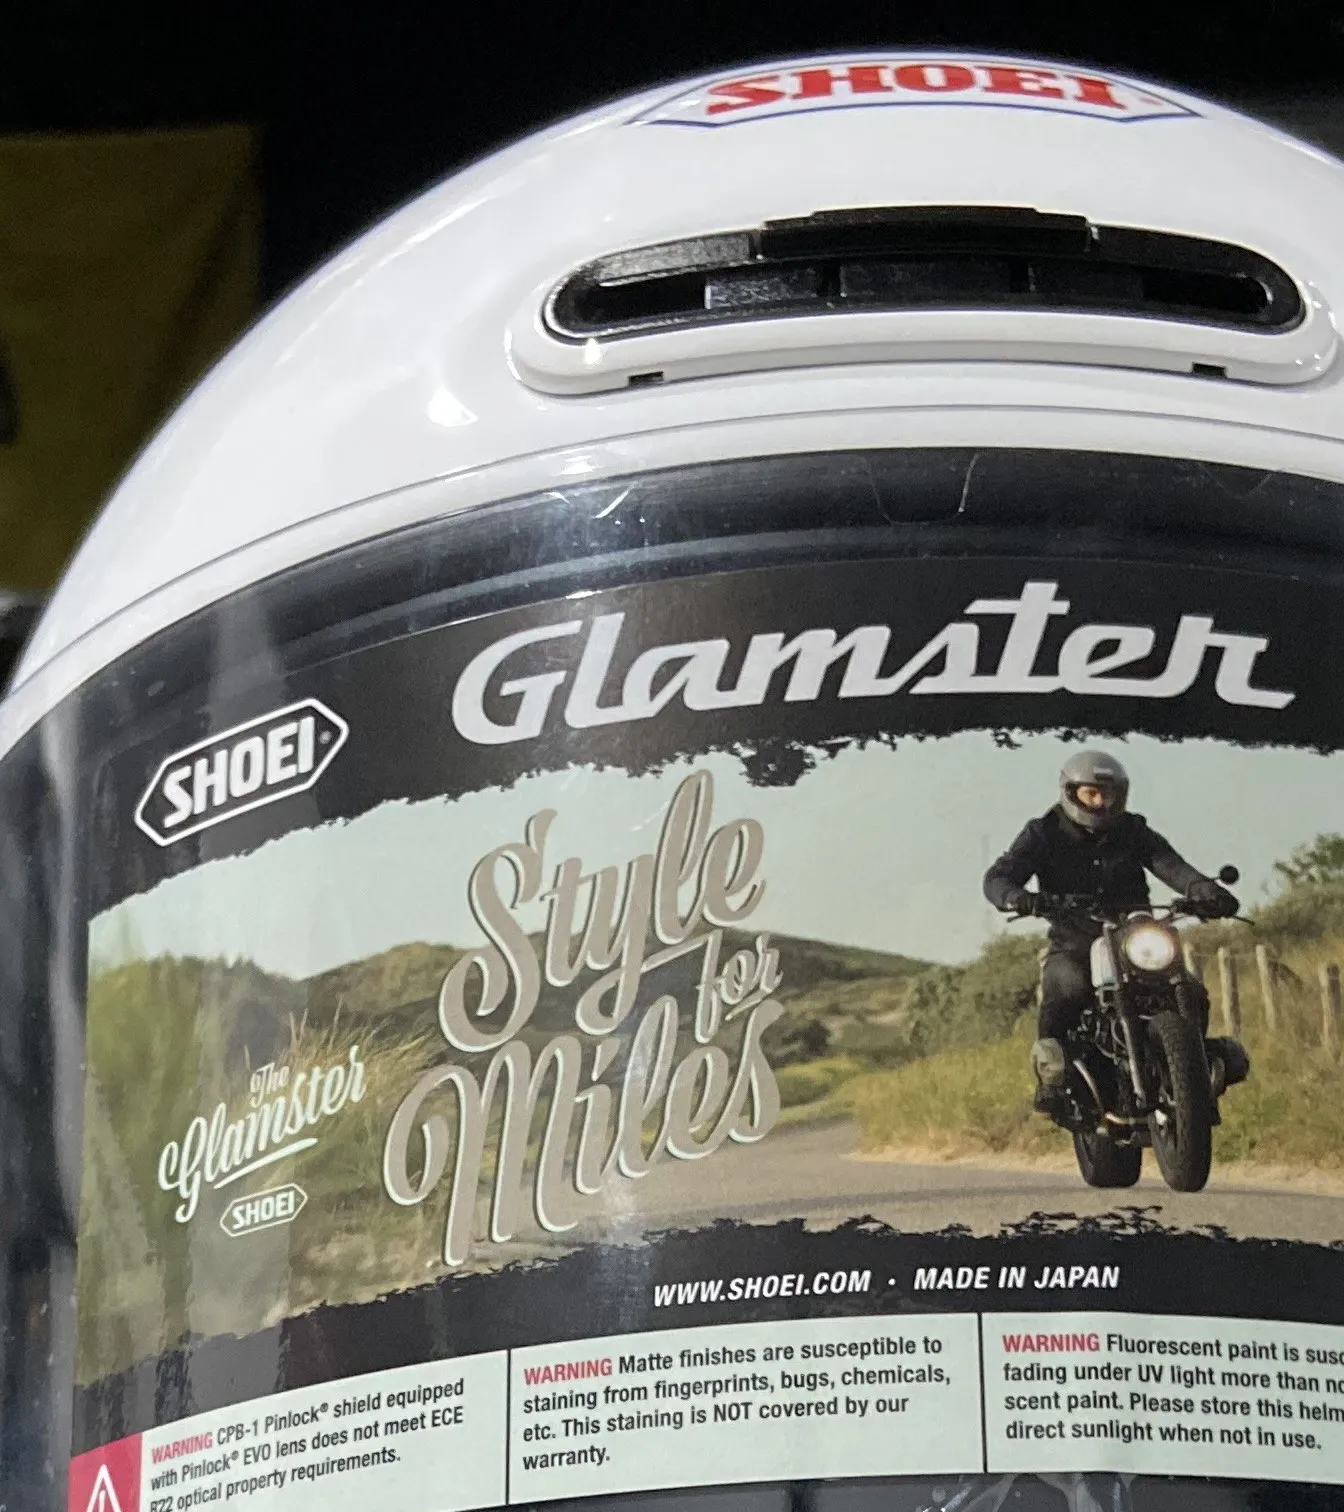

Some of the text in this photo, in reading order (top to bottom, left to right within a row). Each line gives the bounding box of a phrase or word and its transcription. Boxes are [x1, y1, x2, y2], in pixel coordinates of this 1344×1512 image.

[706, 64, 1127, 115] SHOEI
[452, 581, 1296, 746] Glamster
[163, 716, 316, 829] SHOEI
[439, 770, 764, 1053] Style
[694, 930, 784, 1042] for
[250, 1062, 289, 1109] The
[159, 1045, 366, 1222] Glamster
[383, 993, 786, 1266] Miles
[232, 1191, 296, 1229] SHOEI
[653, 1265, 1120, 1307] WWW.SHOEI.COM MADE IN JAPAN
[523, 1336, 942, 1385] WARNING Matte finishes are susceptible to
[1002, 1334, 1100, 1353] WARNING
[1106, 1334, 1223, 1358] Fluorescent
[1228, 1340, 1278, 1363] paint
[1283, 1344, 1299, 1361] is
[523, 1364, 951, 1414] staining from fingerprints, bugs, chemicals,
[1003, 1364, 1067, 1385] fading
[1074, 1365, 1132, 1382] under
[1137, 1366, 1163, 1384] UV
[1169, 1365, 1216, 1390] light
[1221, 1372, 1271, 1389] more
[1277, 1372, 1320, 1393] than
[151, 1432, 213, 1465] WARNING
[216, 1419, 259, 1447] CPB-1
[334, 1389, 381, 1418] shield
[386, 1377, 465, 1409] equipped
[523, 1395, 908, 1441] etc. This staining is NOT covered by our
[1004, 1392, 1061, 1410] scent
[1067, 1392, 1124, 1414] paint.
[1130, 1393, 1195, 1414] Please
[1201, 1398, 1251, 1416] store
[1257, 1399, 1293, 1420] this
[151, 1466, 177, 1492] with
[243, 1444, 271, 1467] EVO
[276, 1437, 306, 1460] lens
[311, 1429, 348, 1452] does
[353, 1424, 380, 1444] not
[384, 1415, 426, 1437] meet
[431, 1405, 464, 1428] ECE
[523, 1446, 610, 1471] warranty.
[1006, 1420, 1322, 1450] direct sunlight when not in use.
[177, 1483, 222, 1512] optical
[226, 1468, 286, 1501] property
[291, 1447, 402, 1484] requirements.
